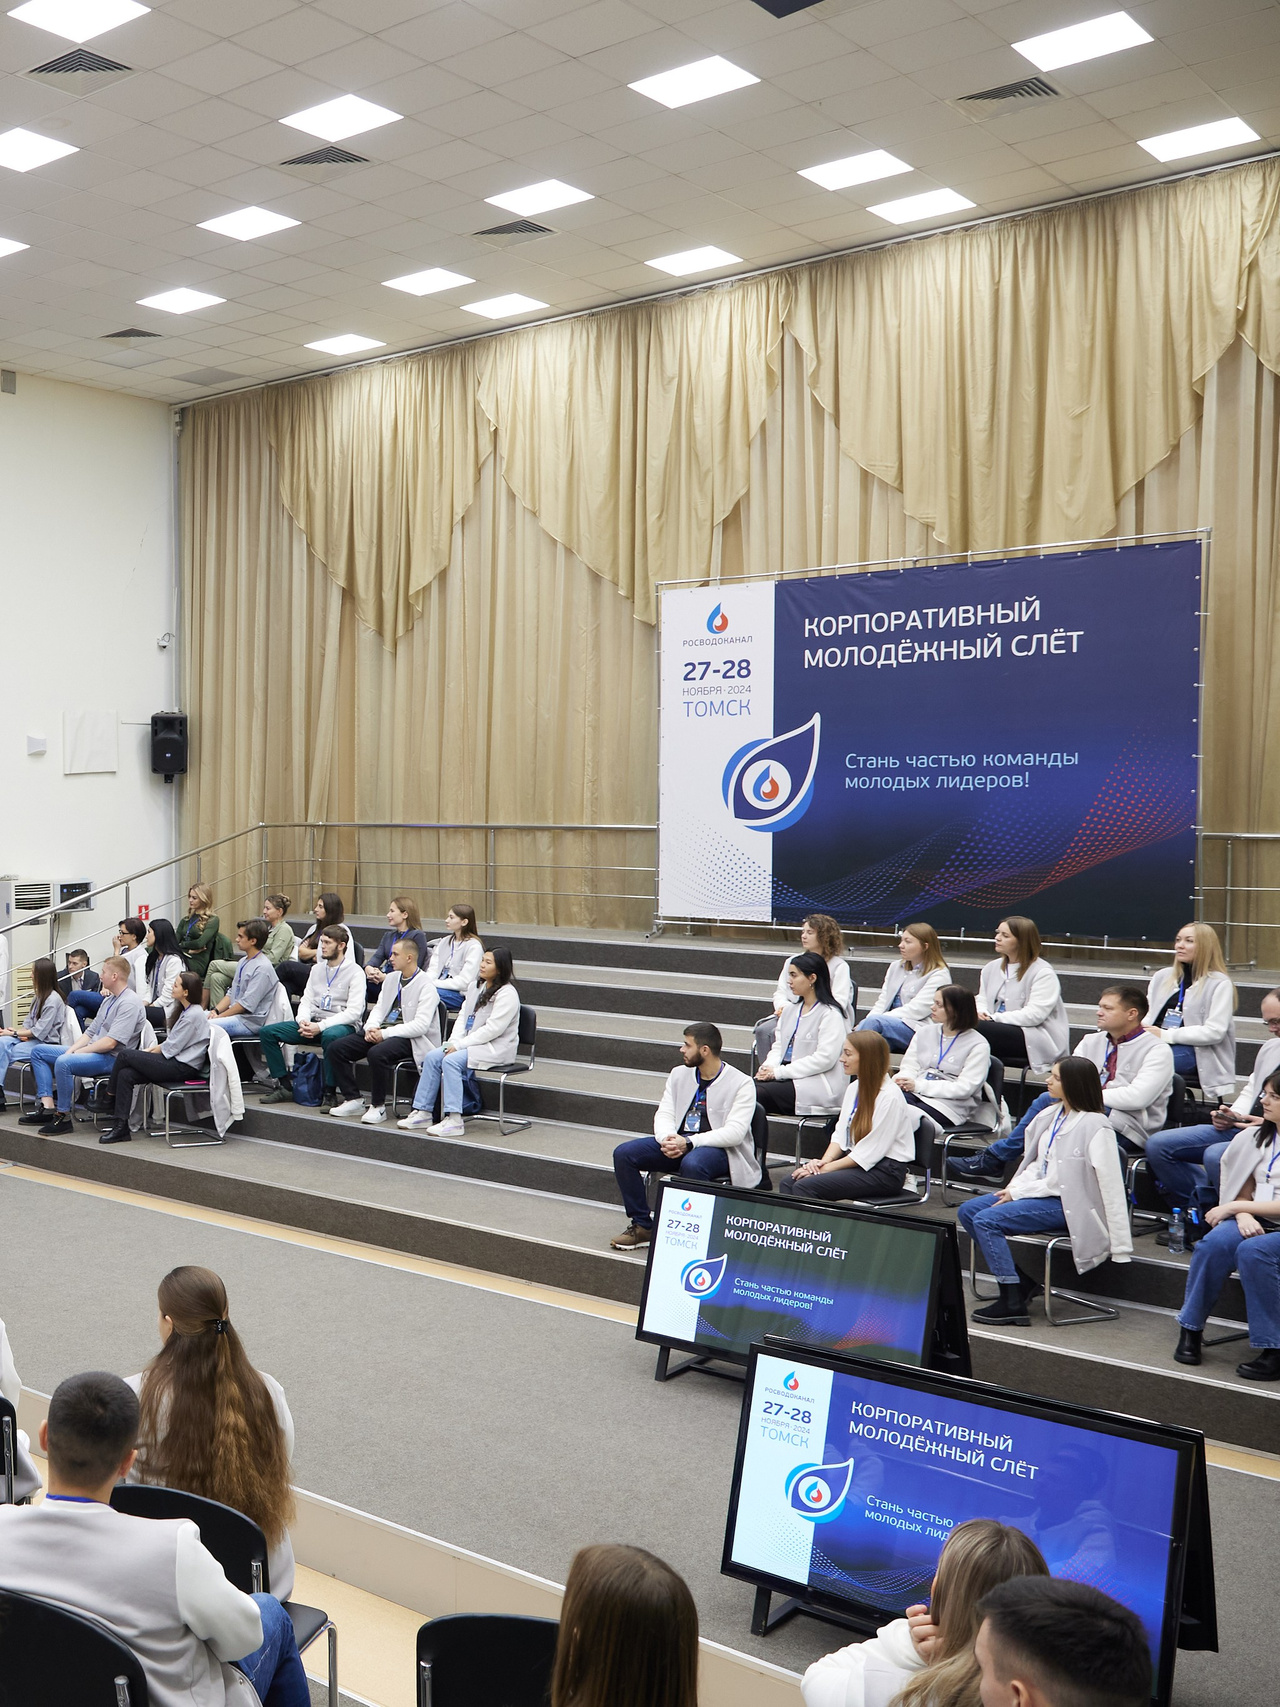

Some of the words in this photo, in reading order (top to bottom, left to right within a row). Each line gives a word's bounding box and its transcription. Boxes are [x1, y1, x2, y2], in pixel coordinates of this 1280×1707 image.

[804, 595, 1040, 638] КОРПОРАТИВНЫЙ
[682, 635, 753, 647] РОСВОДОКАНАЛ
[804, 632, 1002, 669] МОЛОДЁЖНЫЙ
[1011, 628, 1084, 657] СЛЁТ
[683, 659, 752, 681] 27-28
[682, 685, 722, 697] НОЯБРЯ
[727, 684, 751, 695] 2024
[682, 699, 751, 717] ТОМСК
[845, 753, 900, 769] Стань
[906, 753, 976, 768] частью
[982, 752, 1079, 768] команды
[845, 775, 930, 791] молодых
[935, 771, 1029, 791] лидеров!
[667, 1219, 700, 1233] 27-28
[726, 1215, 832, 1243] КОРПОРАТИВНЫЙ
[665, 1236, 698, 1250] ТОМСК
[724, 1228, 813, 1254] МОЛОДЁЖНЫЙ
[816, 1246, 848, 1260] СЛЁТ
[733, 1288, 771, 1301] молодых
[773, 1296, 813, 1310] лидеров!
[734, 1277, 759, 1290] Стань
[761, 1284, 792, 1297] частью
[793, 1291, 834, 1305] команды
[764, 1386, 815, 1404] РОСВОДОКАНАЛ
[763, 1401, 812, 1424] 27-28
[761, 1425, 809, 1448] ТОМСК
[851, 1401, 1014, 1453] КОРПОРАТИВНЫЙ
[849, 1421, 985, 1467] МОЛОДЁЖНЫЙ
[990, 1457, 1039, 1480] СЛЁТ
[864, 1509, 923, 1533] молодых
[866, 1494, 904, 1514] Стань
[907, 1507, 954, 1528] частью
